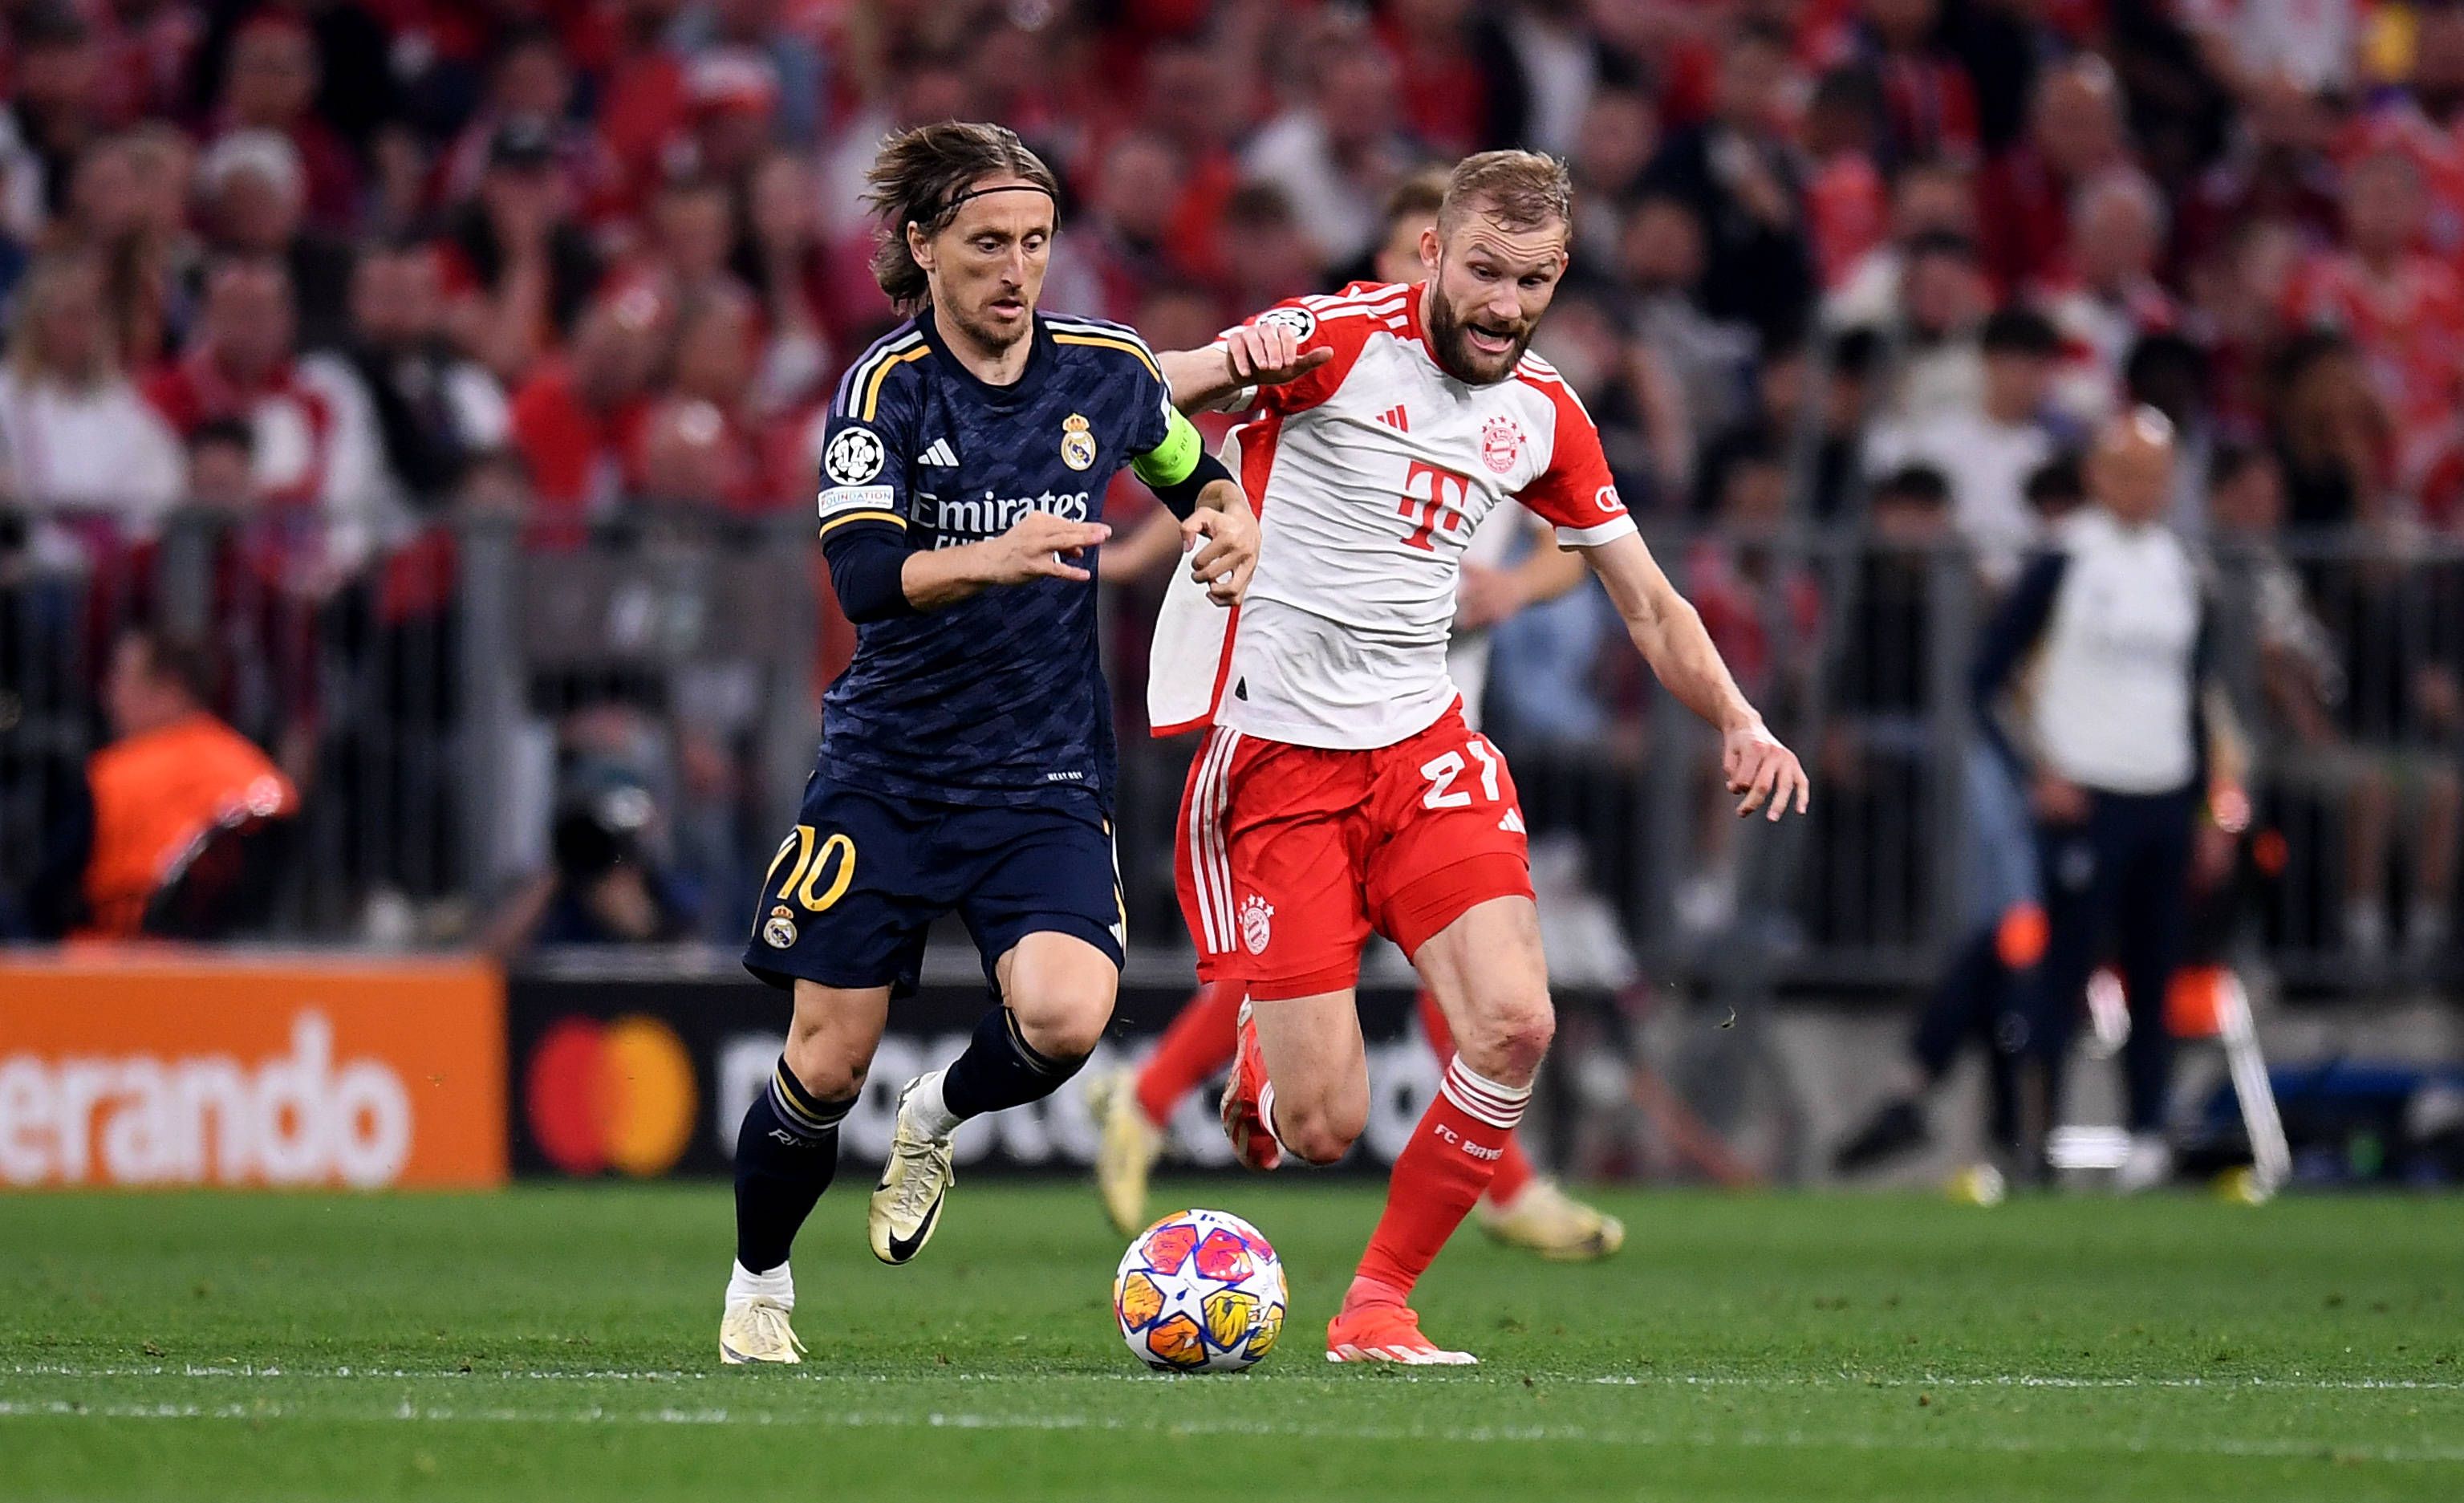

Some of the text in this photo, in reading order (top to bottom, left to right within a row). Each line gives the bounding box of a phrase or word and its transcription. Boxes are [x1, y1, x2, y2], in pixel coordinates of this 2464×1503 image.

[821, 490, 891, 507] FOUNDATION
[911, 489, 1089, 533] Emirates
[1419, 740, 1500, 810] 21
[776, 824, 856, 912] 10
[0, 1008, 415, 1189] erando
[1433, 1123, 1459, 1145] FC
